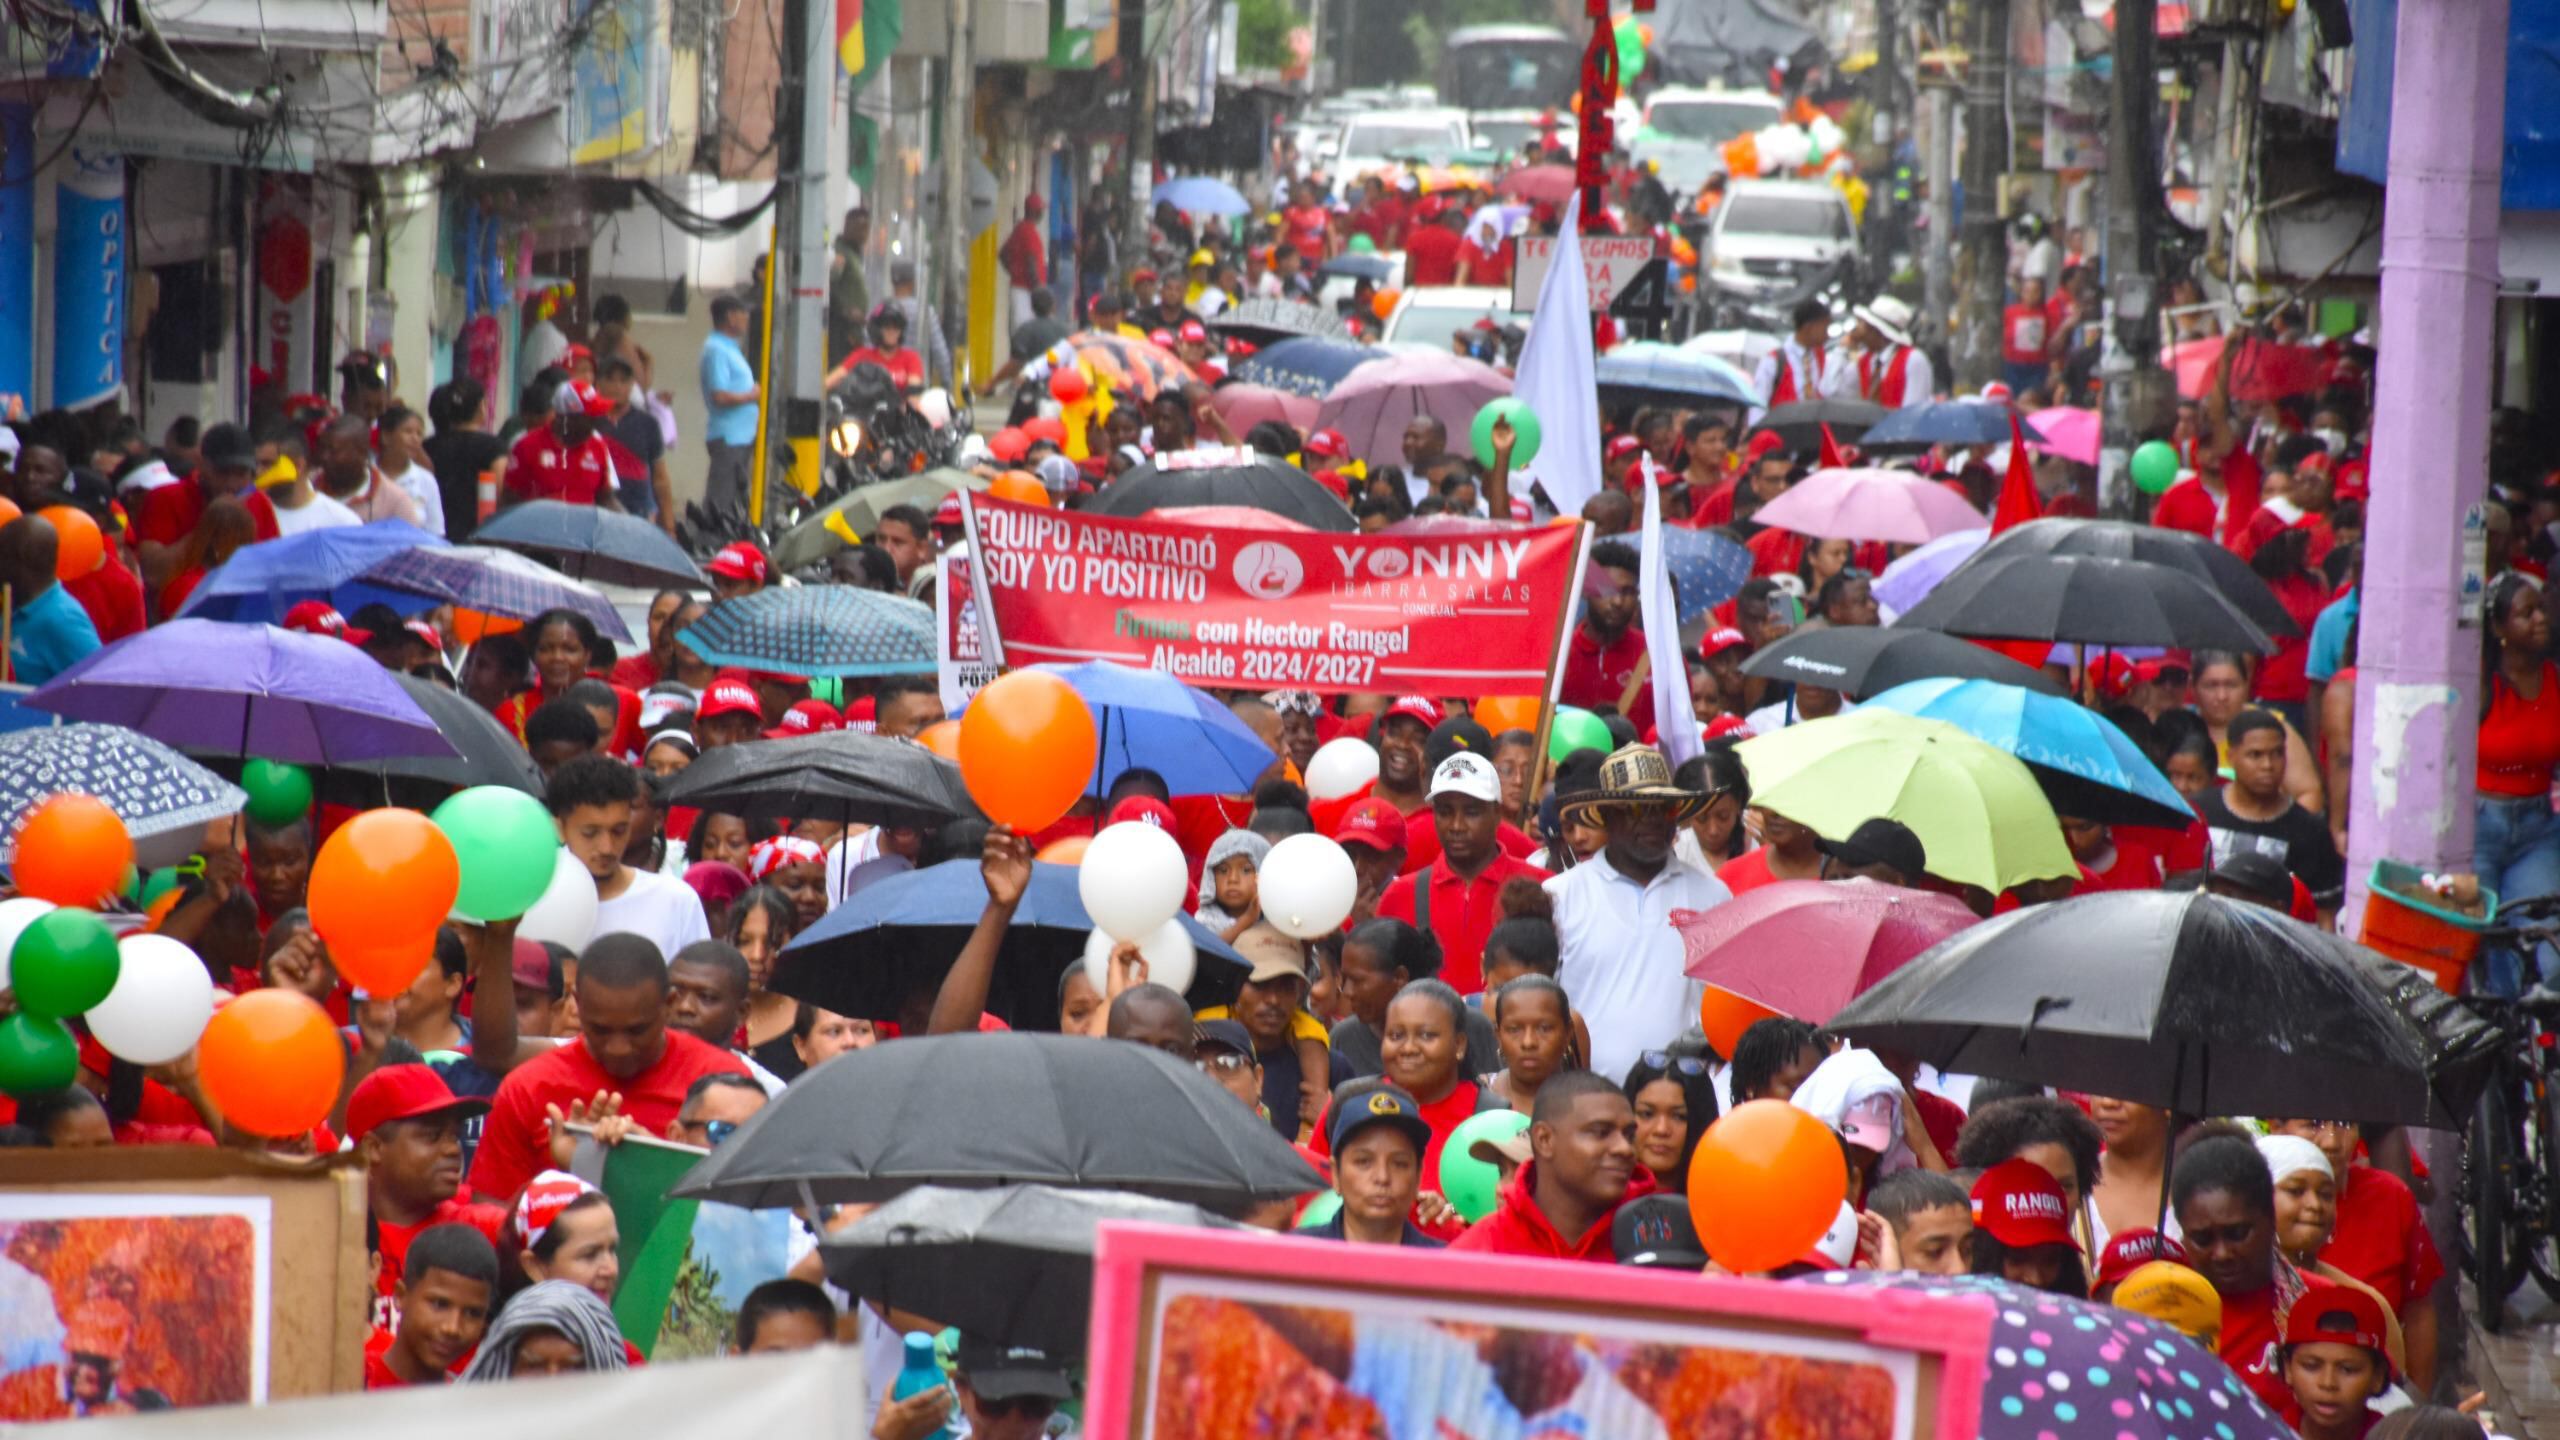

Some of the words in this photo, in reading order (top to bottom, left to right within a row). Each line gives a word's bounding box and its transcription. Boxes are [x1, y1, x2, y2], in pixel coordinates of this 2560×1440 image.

[975, 508, 1072, 551] EQUIPO
[1077, 524, 1217, 571] APARTADÓ
[1332, 538, 1532, 581] YONNY
[983, 547, 1034, 591] SOY
[1042, 554, 1077, 594] YO
[1083, 558, 1207, 604] POSITIVO
[1331, 581, 1428, 600] IBARRA
[1447, 583, 1531, 604] SALAS
[1402, 602, 1458, 618] CONCEJAL
[1114, 608, 1191, 641] Firmes
[1196, 619, 1238, 645] con
[1244, 616, 1323, 650] Hector
[1328, 620, 1411, 659] Rangel
[1150, 645, 1237, 679] Alcalde
[1241, 650, 1377, 686] 2024/2027
[2005, 1191, 2064, 1216] RANGEL
